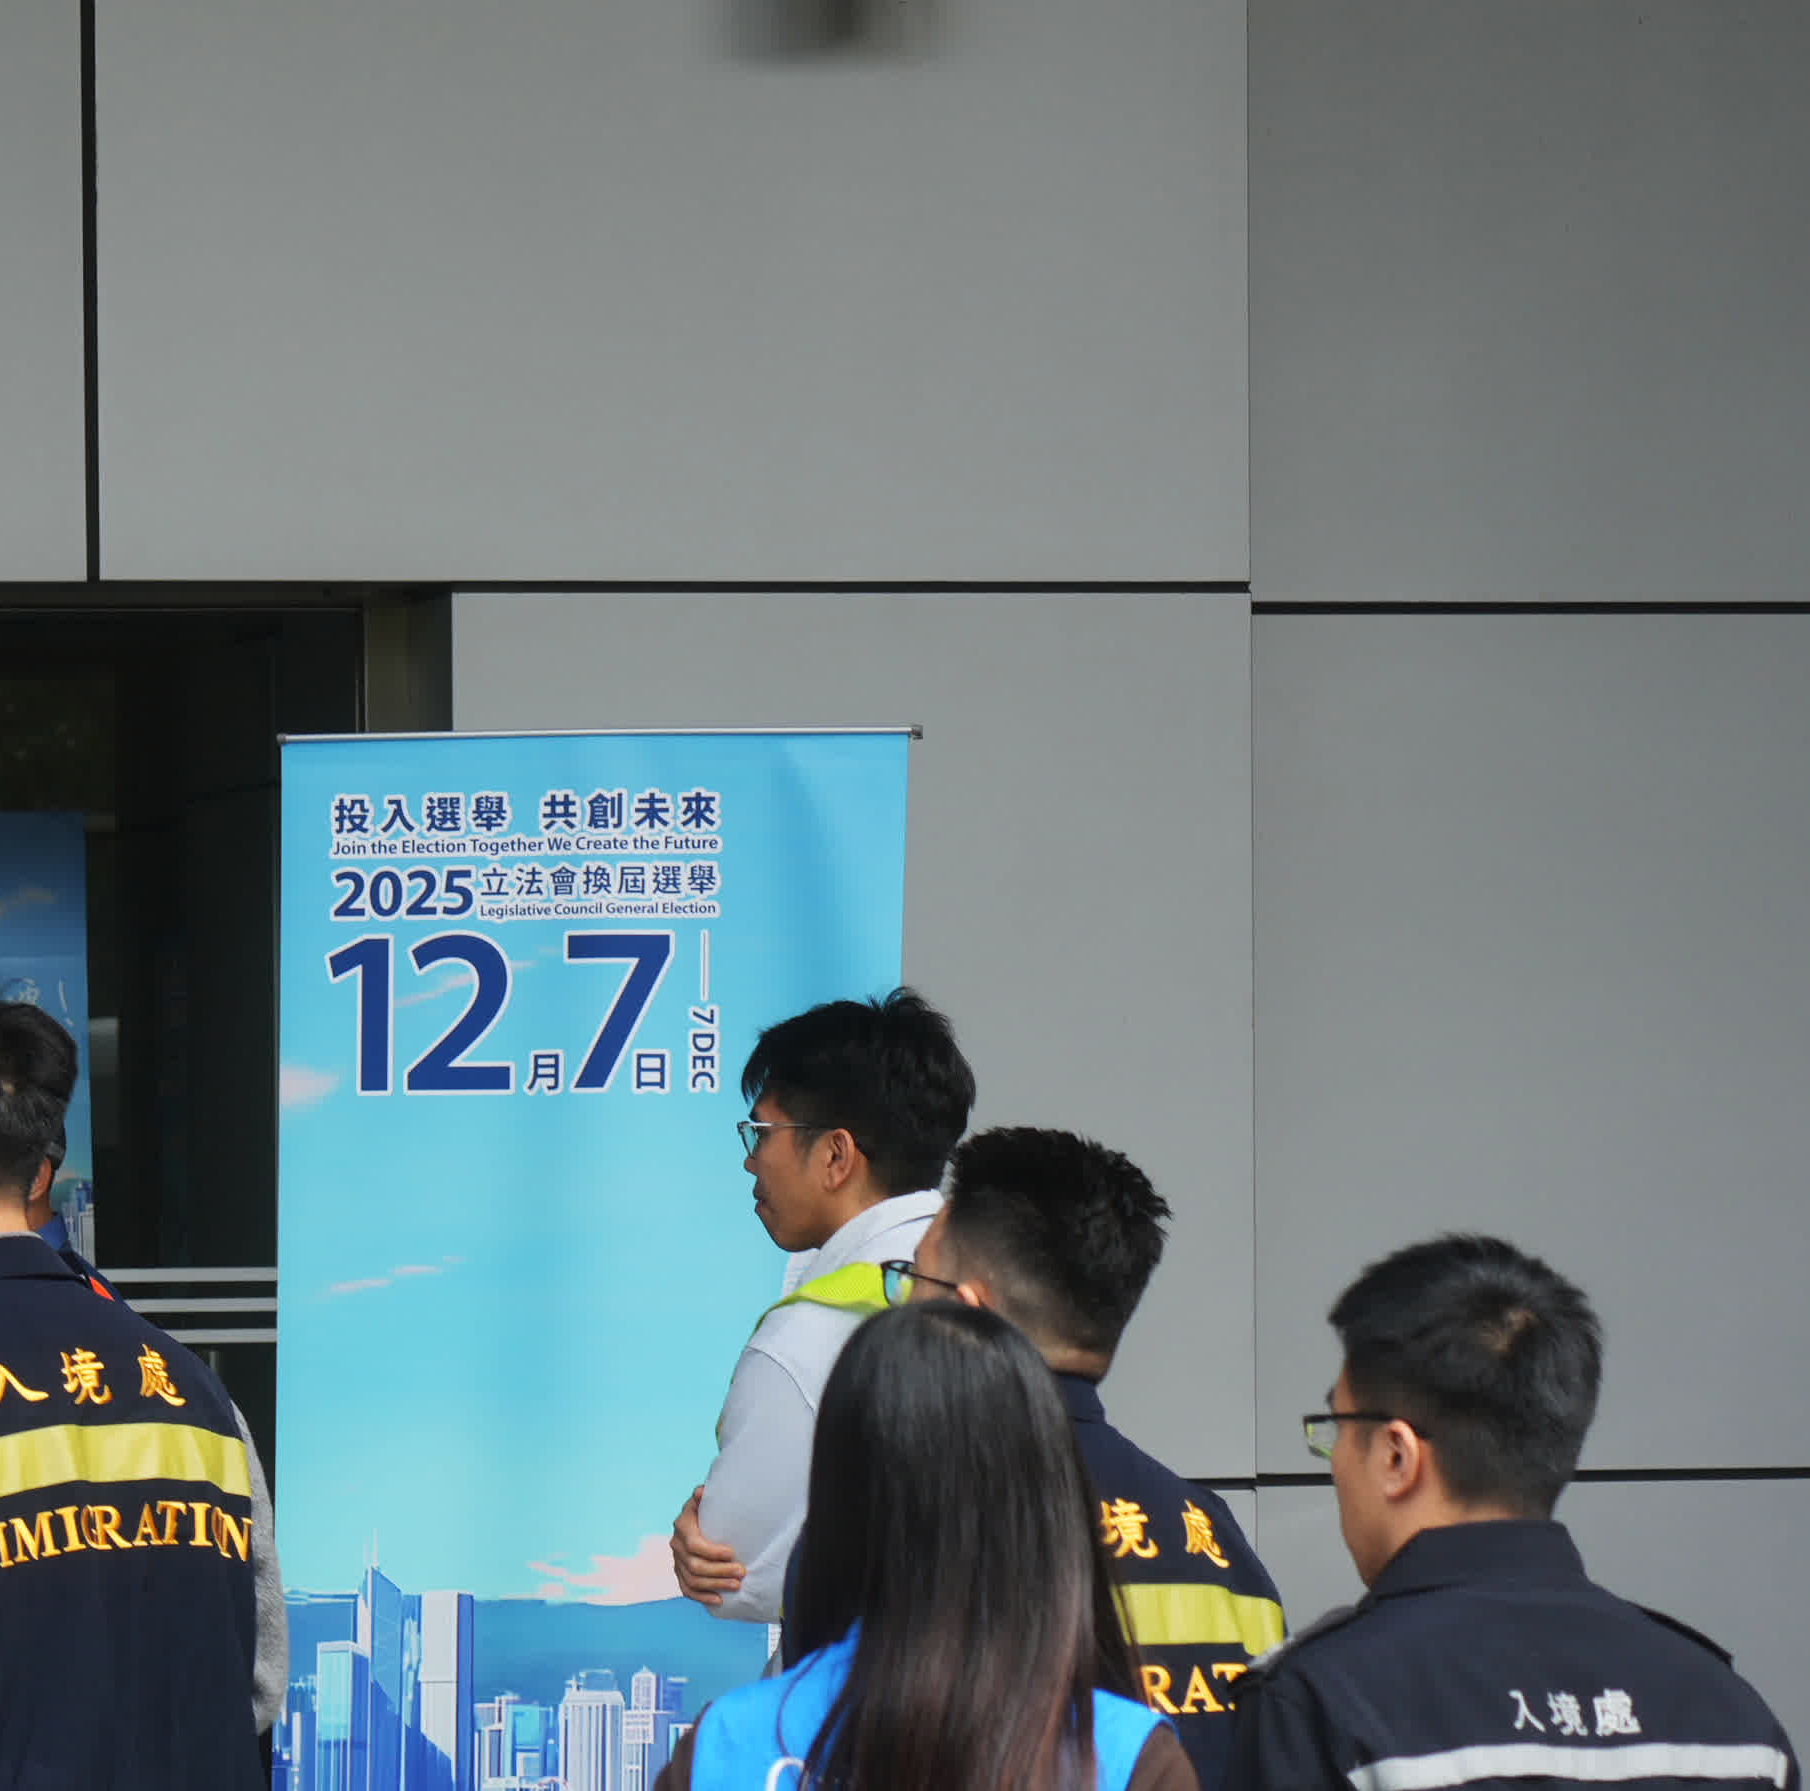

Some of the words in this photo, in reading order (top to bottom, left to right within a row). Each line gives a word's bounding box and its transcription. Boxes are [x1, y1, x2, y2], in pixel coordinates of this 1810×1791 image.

[334, 795, 507, 834] 投入選舉
[542, 792, 716, 830] 共創未來
[334, 841, 366, 855] Join
[371, 840, 397, 855] the
[402, 840, 466, 854] Election
[470, 838, 544, 856] Together
[547, 837, 572, 851] We
[576, 836, 628, 850] Create
[633, 836, 660, 850] the
[664, 835, 718, 850] Future
[334, 869, 474, 917] 2025
[481, 865, 716, 897] 立法會換屆選舉
[481, 903, 551, 920] Legislative
[554, 902, 603, 915] Council
[606, 902, 659, 915] General
[662, 901, 716, 914] Election
[1508, 1688, 1642, 1737] 入境處
